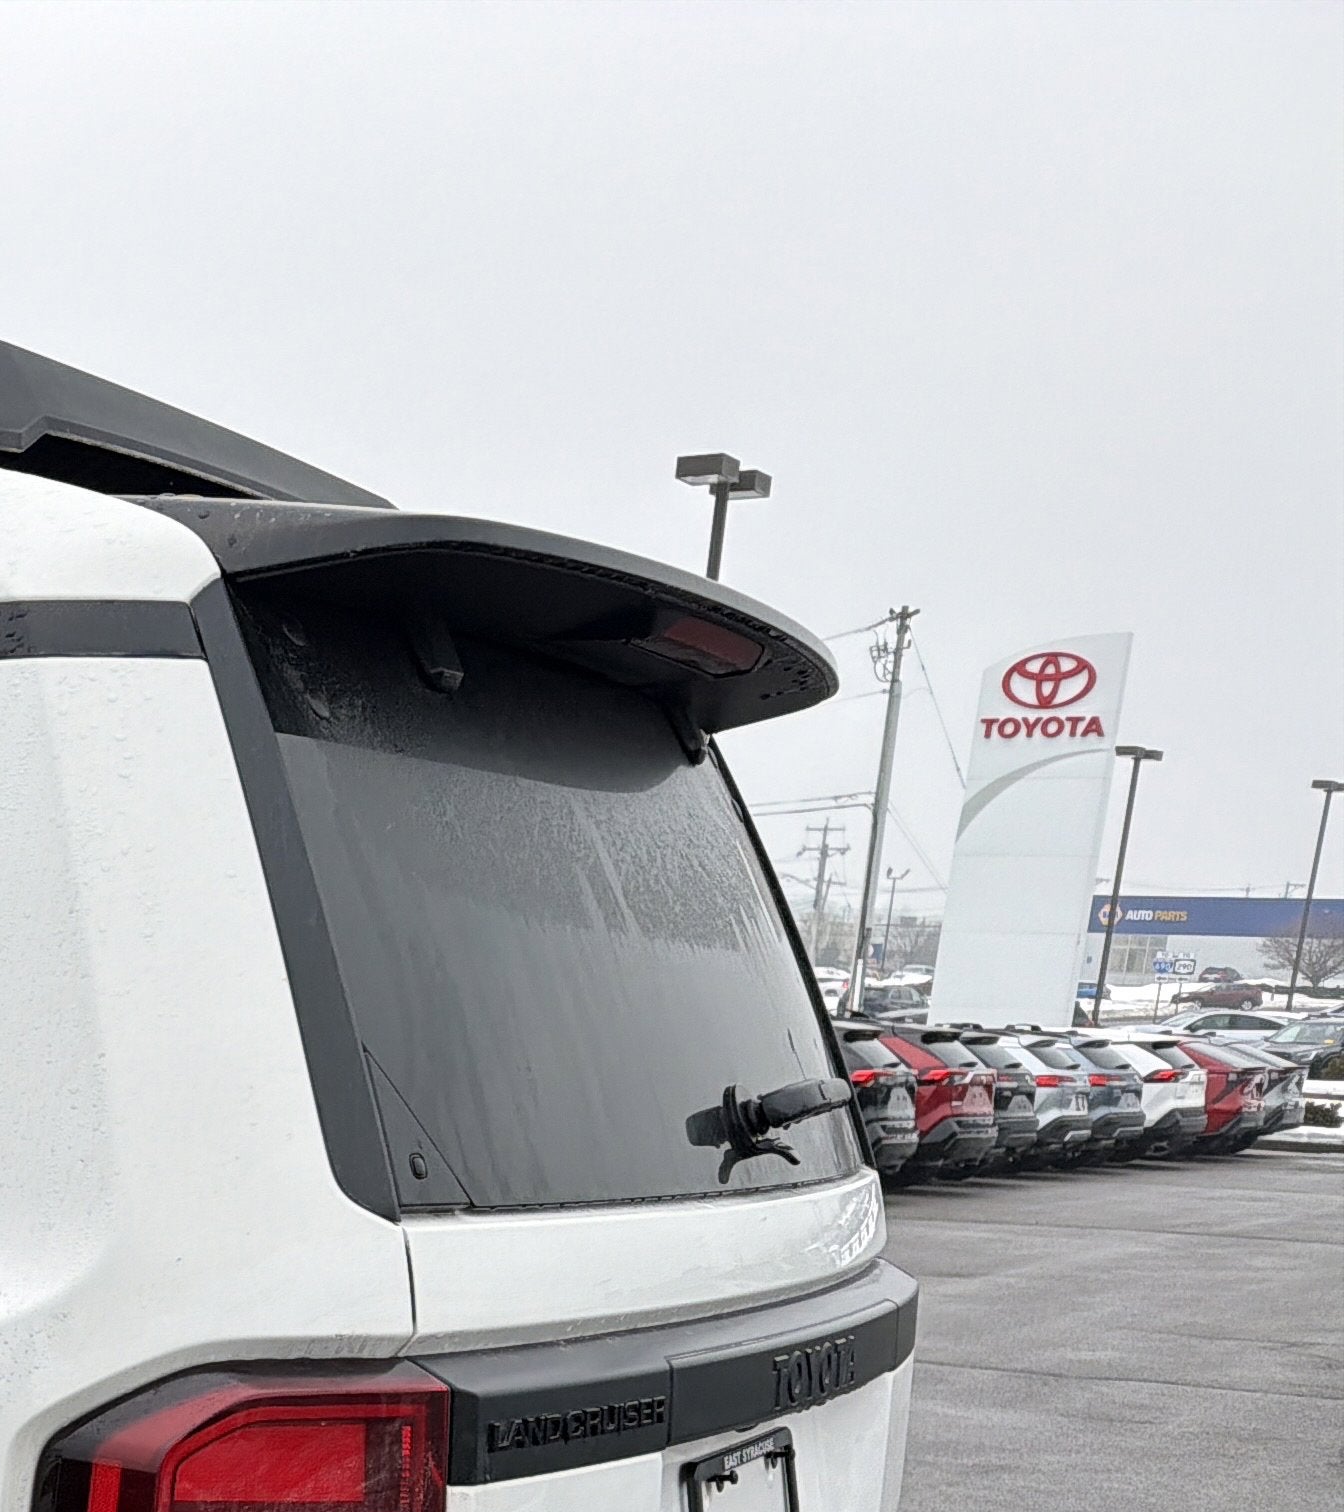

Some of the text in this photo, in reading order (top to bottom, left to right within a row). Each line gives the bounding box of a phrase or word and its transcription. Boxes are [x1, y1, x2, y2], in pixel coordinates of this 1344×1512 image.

[980, 715, 1105, 739] TOYOTA
[1124, 909, 1153, 921] AUTO
[1154, 910, 1188, 922] PARTS
[1177, 963, 1193, 971] 290
[773, 1335, 855, 1411] TOYOTA
[723, 1437, 774, 1470] EAST SYRACUSE
